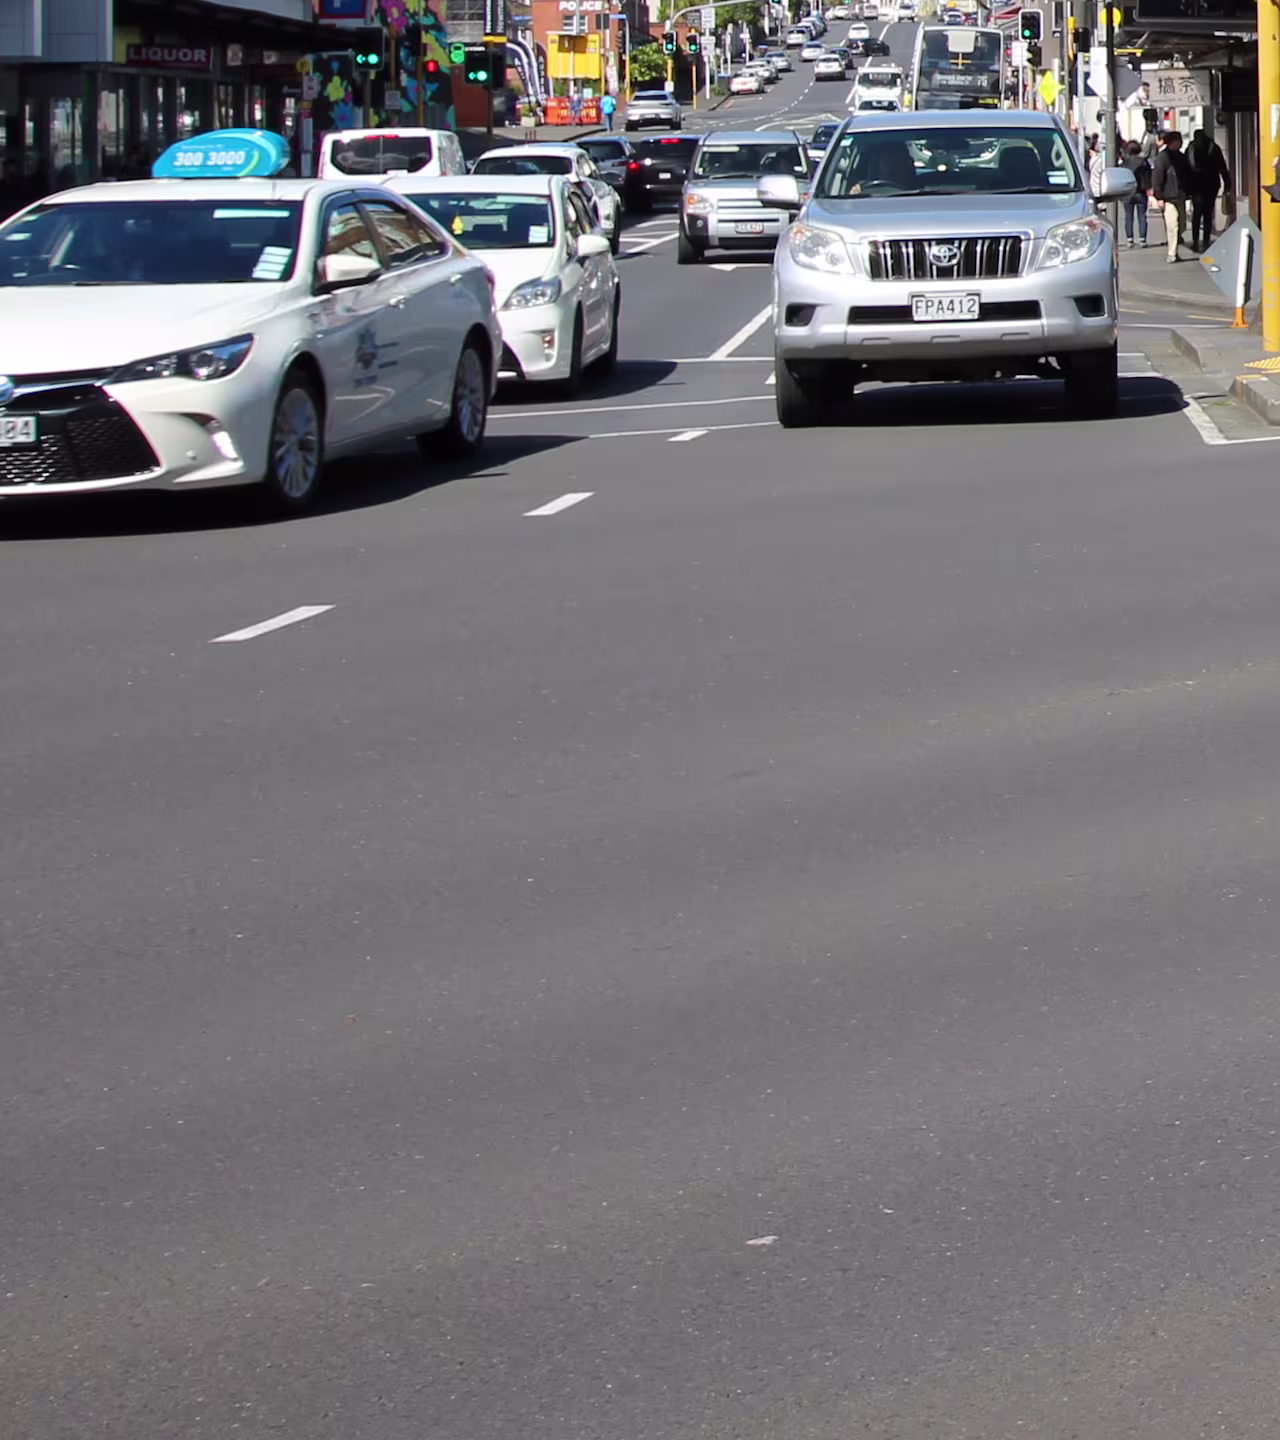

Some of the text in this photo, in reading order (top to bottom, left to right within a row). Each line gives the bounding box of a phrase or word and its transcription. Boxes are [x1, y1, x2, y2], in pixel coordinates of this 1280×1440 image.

[129, 46, 207, 61] LIQUOR
[174, 151, 245, 166] 300 3000
[914, 298, 976, 316] FPA412
